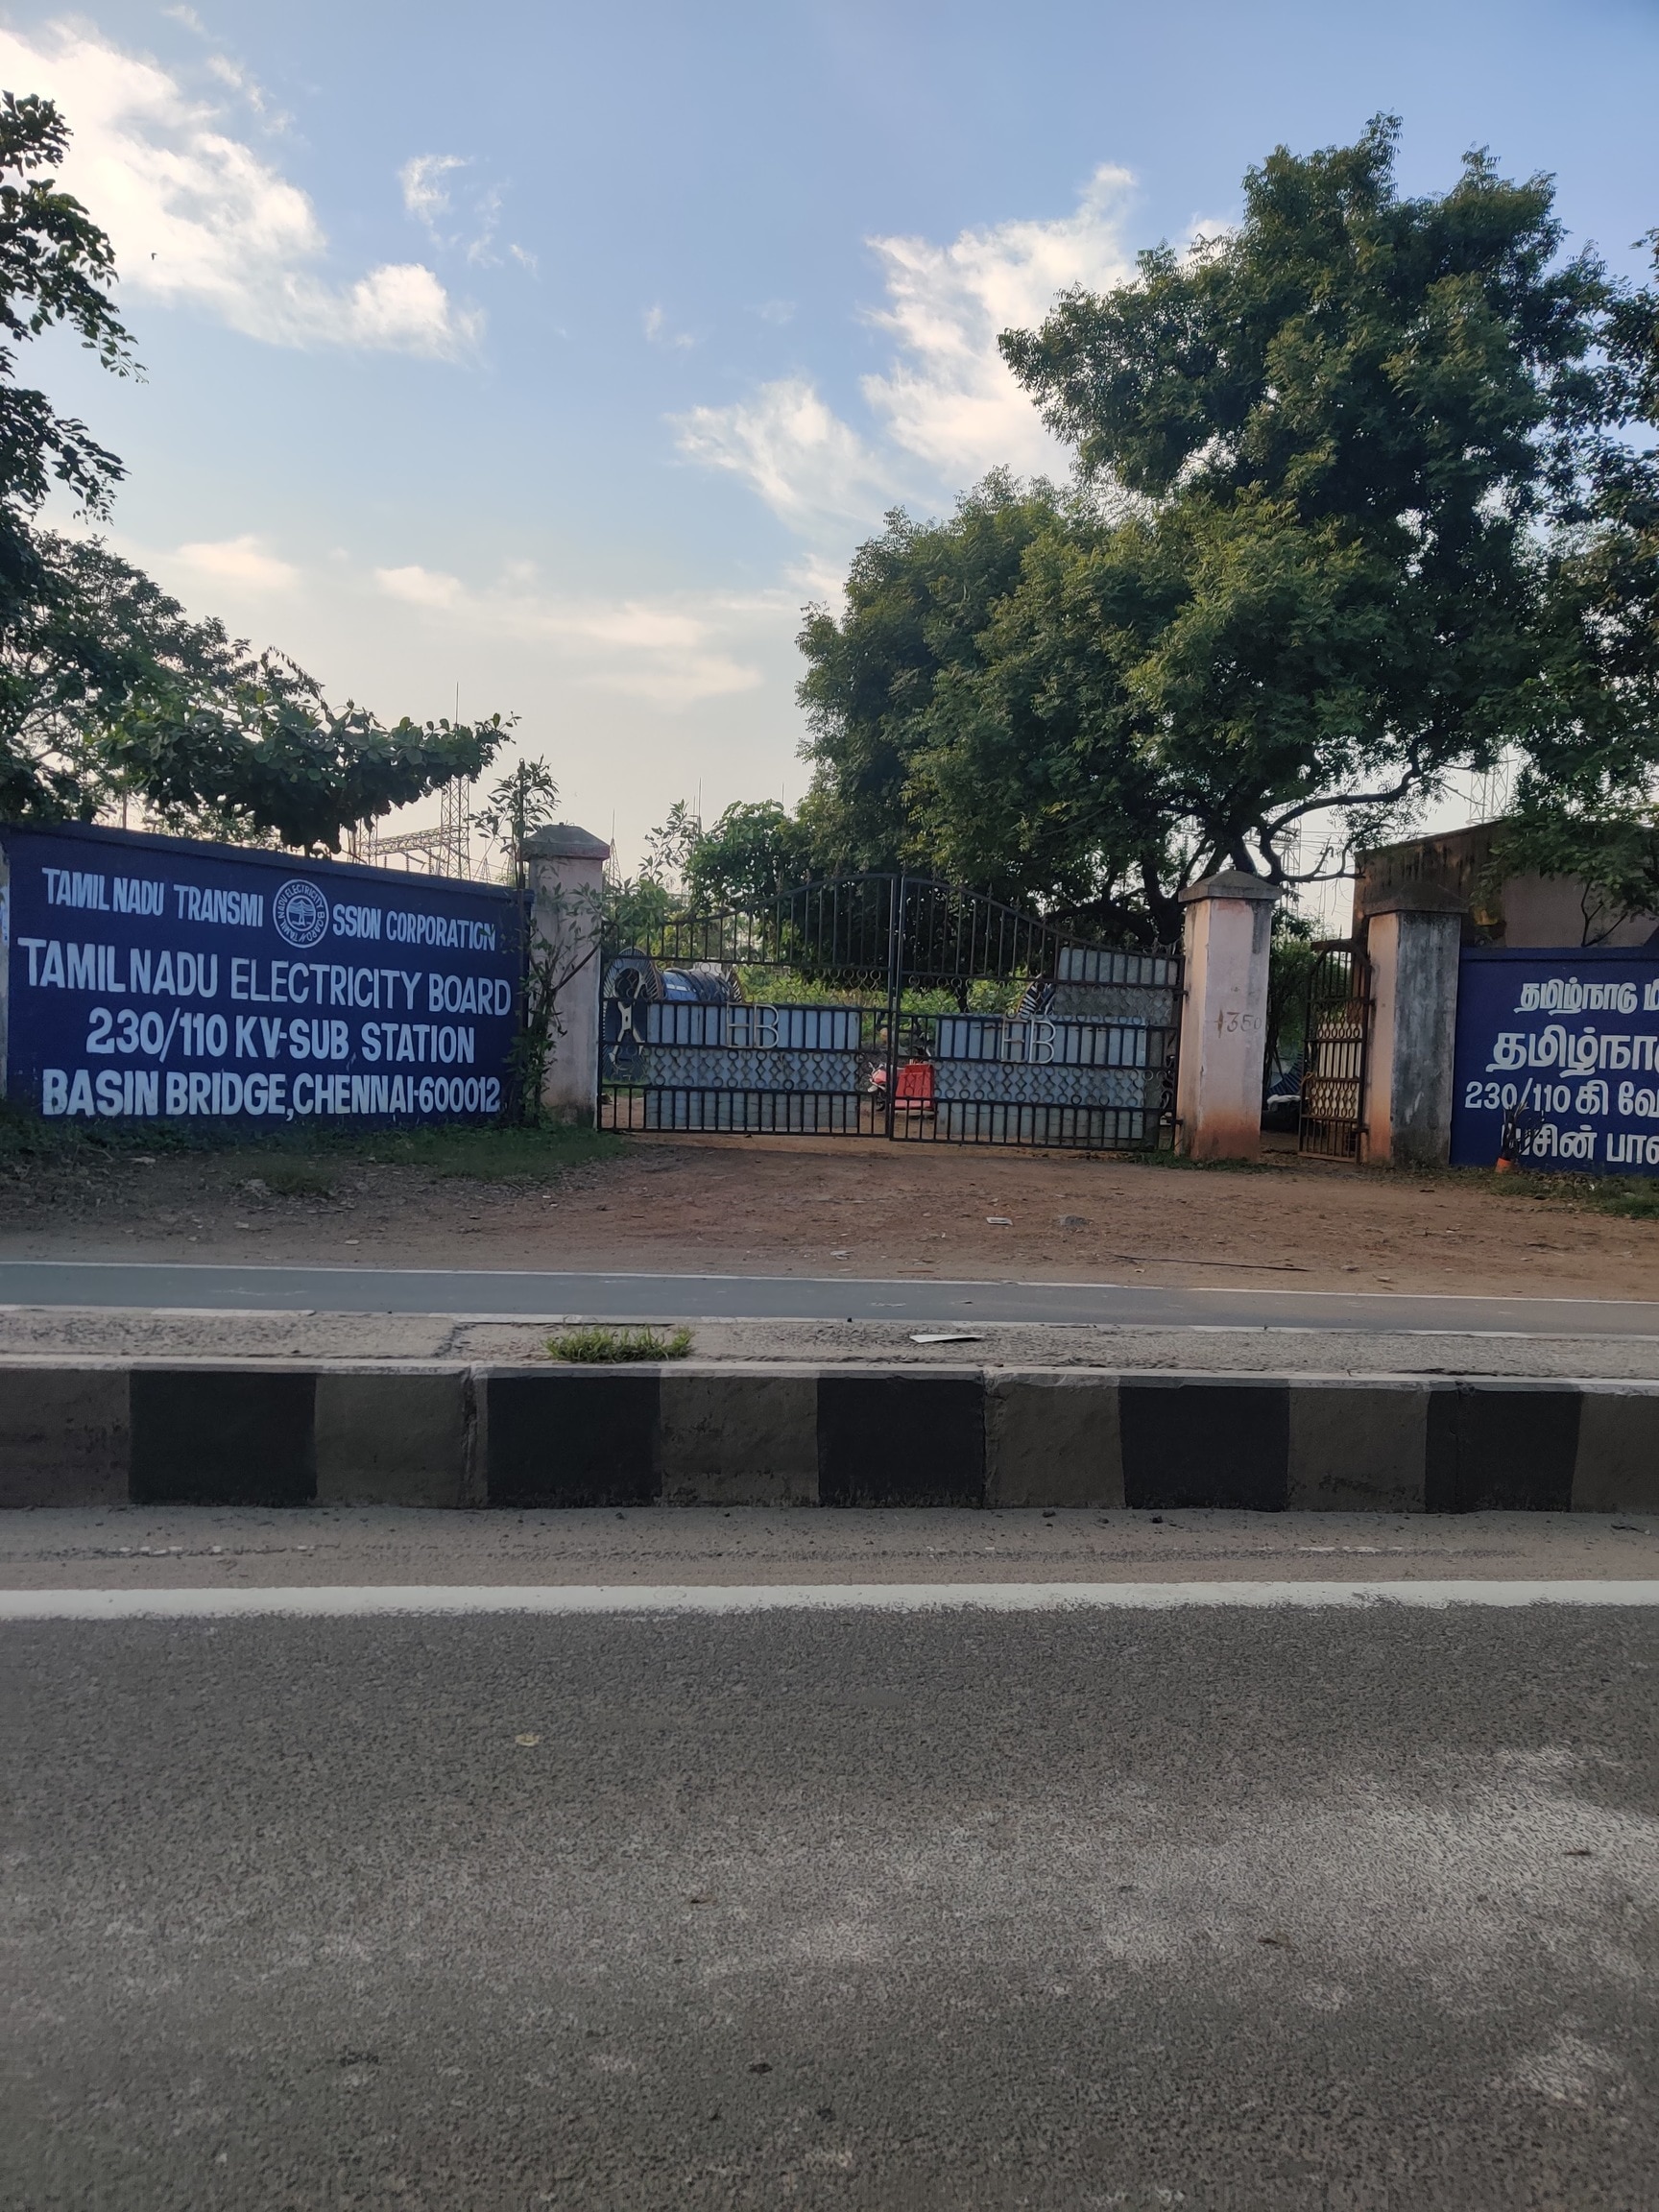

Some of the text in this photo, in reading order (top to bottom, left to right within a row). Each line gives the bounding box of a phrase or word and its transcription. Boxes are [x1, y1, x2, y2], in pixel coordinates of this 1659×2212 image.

[42, 867, 495, 950] TAMIL NADU TRANSMI SSION CORPORATION
[284, 884, 325, 909] ELECTRICITY
[17, 937, 512, 1016] TAMIL NADU ELECTRICITY BOARD
[1513, 976, 1638, 1016] தமிழ்நாடு
[85, 1007, 228, 1063] 230/110
[361, 1022, 475, 1064] STATION
[1485, 1024, 1659, 1078] தமிழ்நா
[42, 1069, 159, 1117] BASIN
[1464, 1077, 1571, 1114] 230/110
